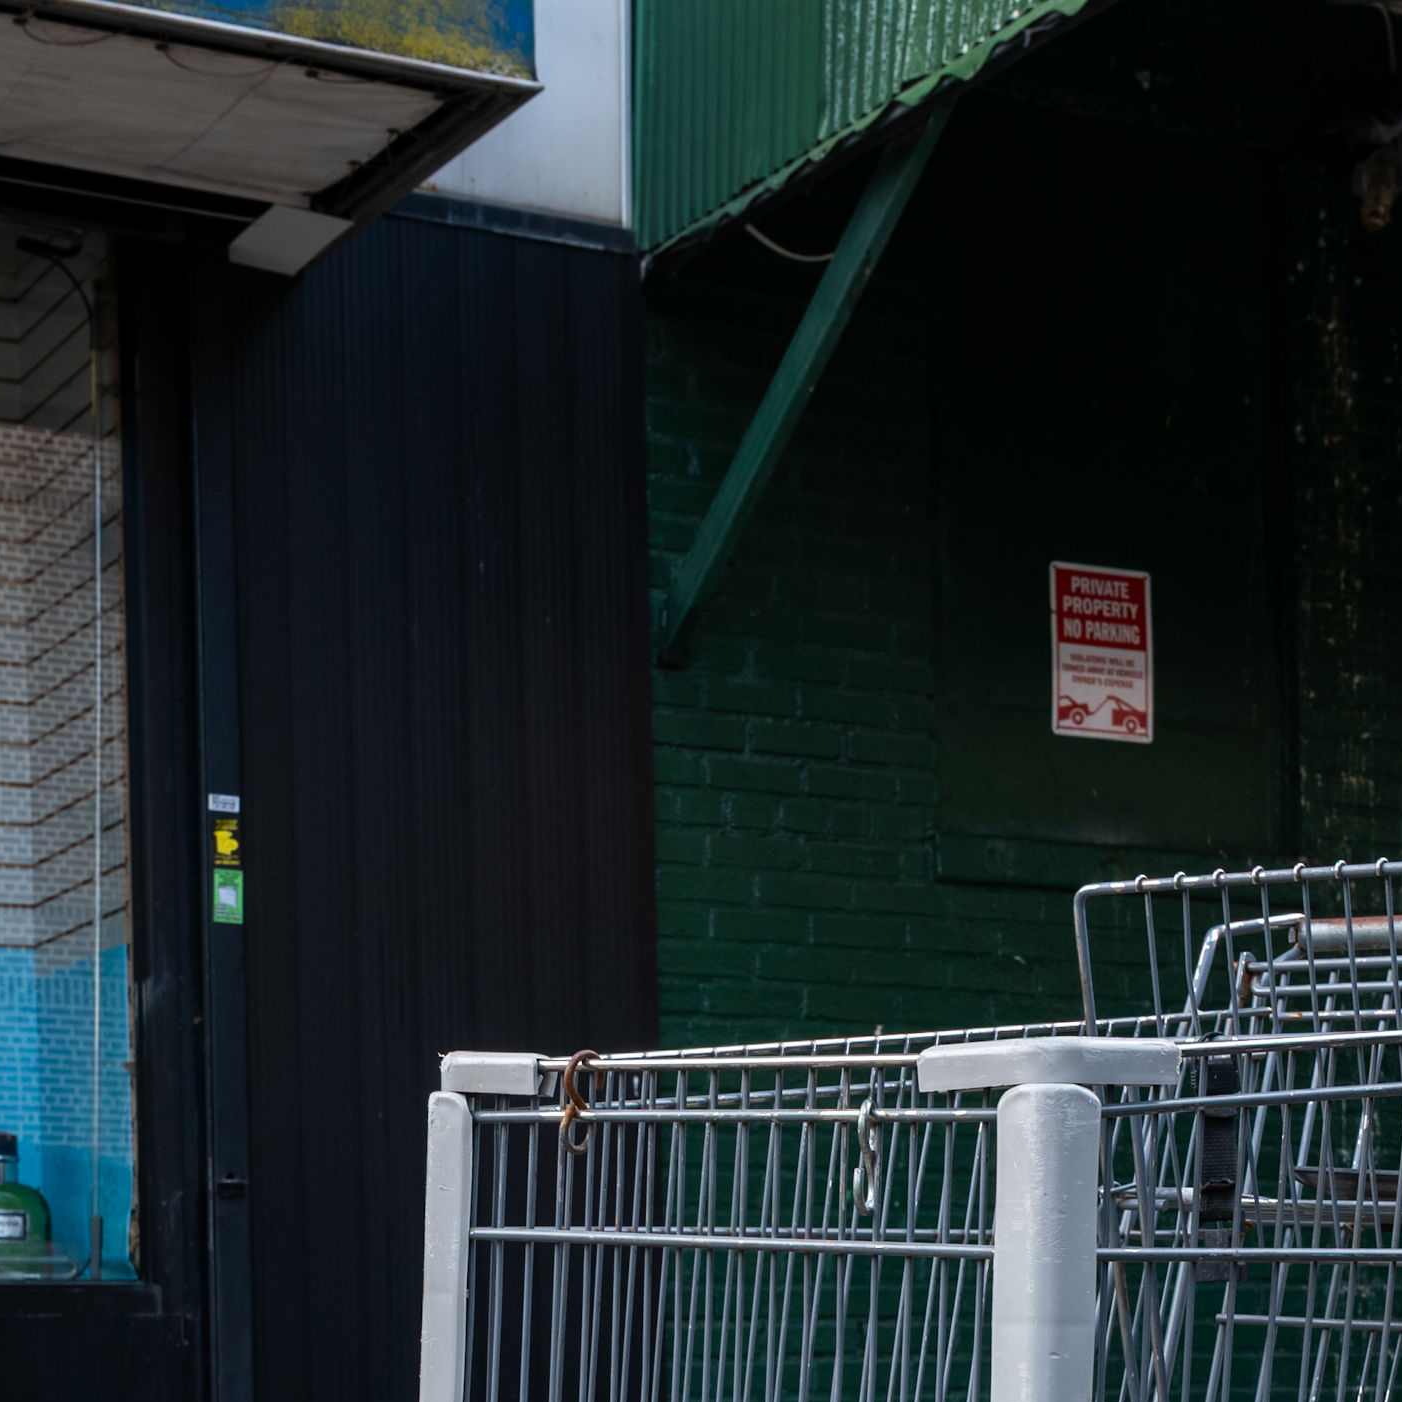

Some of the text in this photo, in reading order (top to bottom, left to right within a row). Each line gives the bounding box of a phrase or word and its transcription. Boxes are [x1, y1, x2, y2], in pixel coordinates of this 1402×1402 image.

[1071, 576, 1130, 599] PRIVATE
[1062, 595, 1139, 619] PROPERTY
[1063, 617, 1140, 645] NO PARKING
